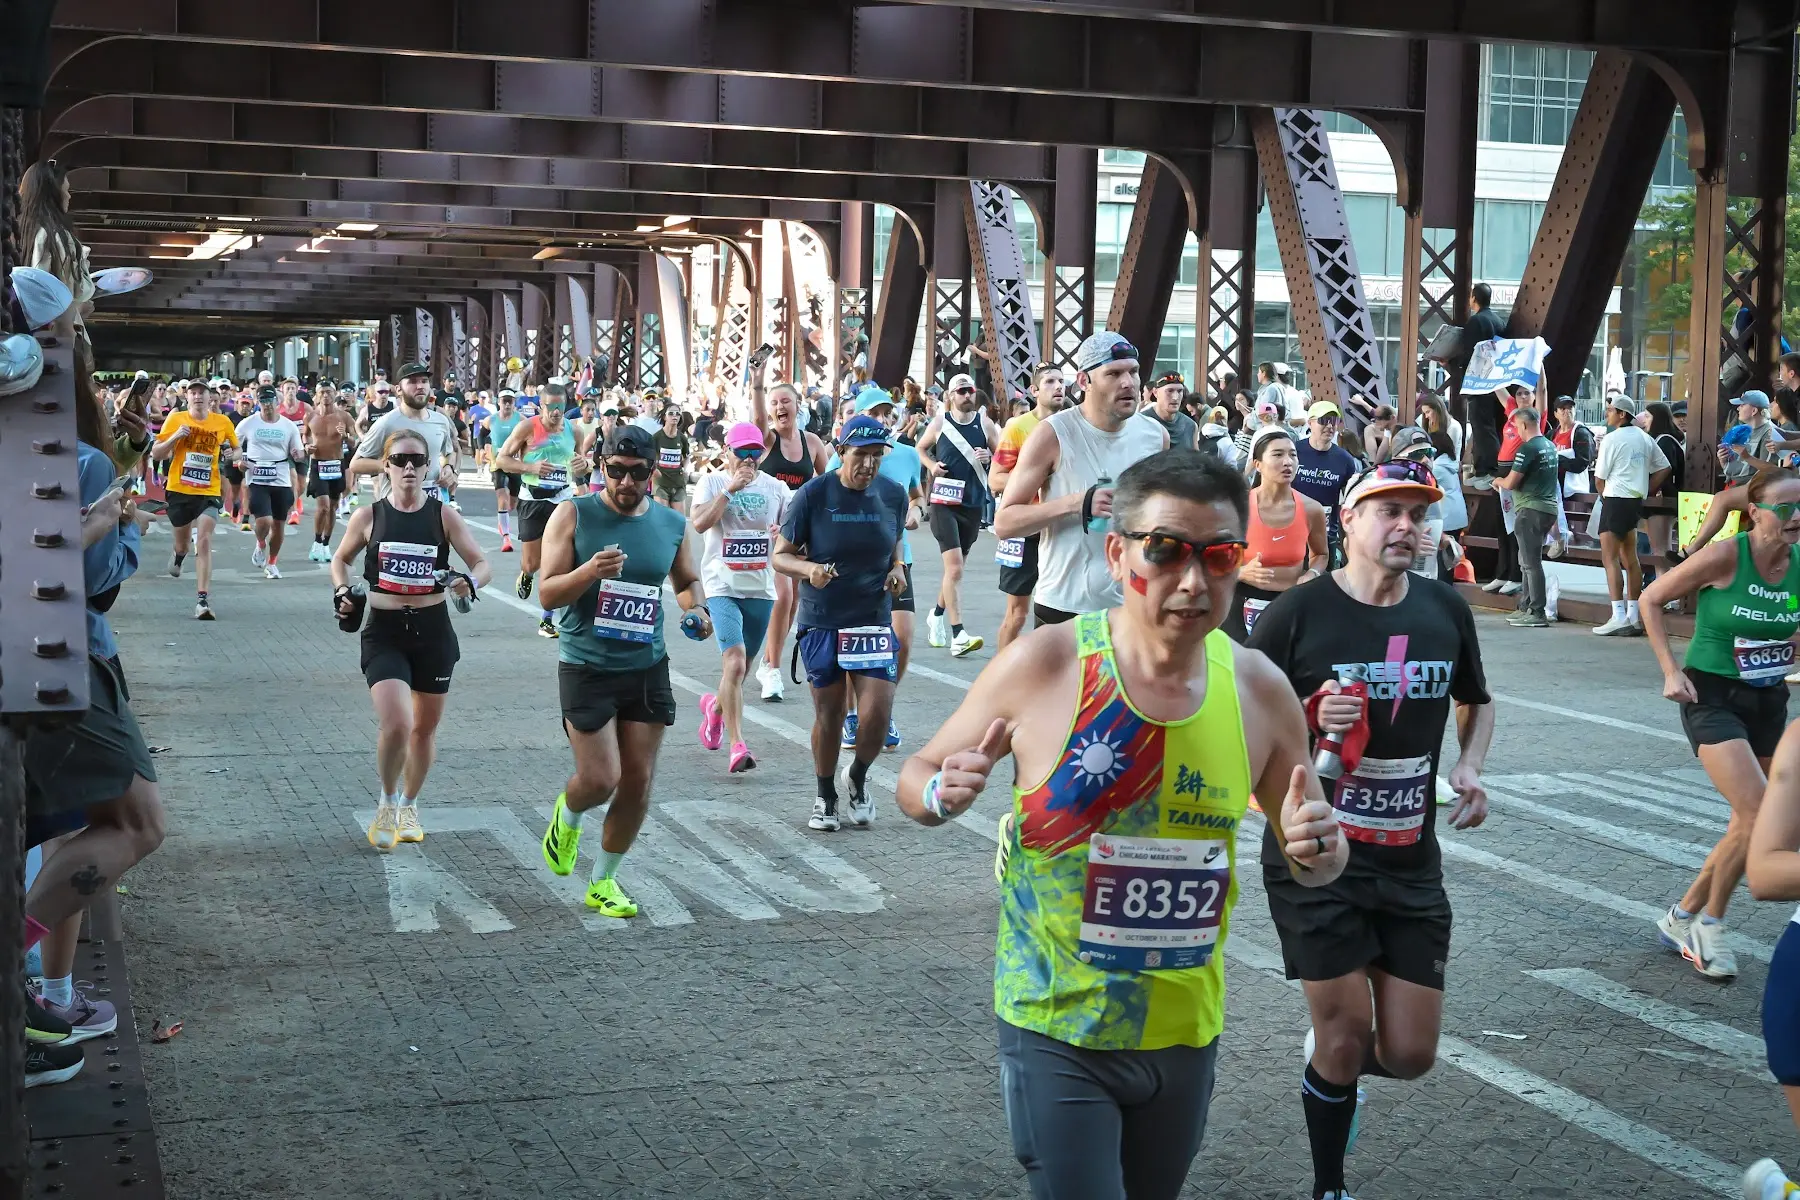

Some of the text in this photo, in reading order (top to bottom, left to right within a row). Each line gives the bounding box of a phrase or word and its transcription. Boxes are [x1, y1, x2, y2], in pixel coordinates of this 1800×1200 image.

[1301, 477, 1332, 487] POLAND
[938, 487, 962, 498] 49011
[725, 543, 767, 555] F 26295
[382, 559, 433, 576] F 29889
[1748, 584, 1790, 603] Olwyn
[601, 599, 654, 621] E 7042
[841, 636, 889, 652] E 7119
[1738, 646, 1793, 668] E 6850
[1404, 660, 1453, 682] CITY
[1367, 682, 1450, 700] ACK CLU
[1341, 784, 1426, 812] F 35445
[1119, 852, 1148, 860] CHICAGO
[1094, 876, 1117, 885] CORRAL
[1094, 878, 1220, 920] E 8352
